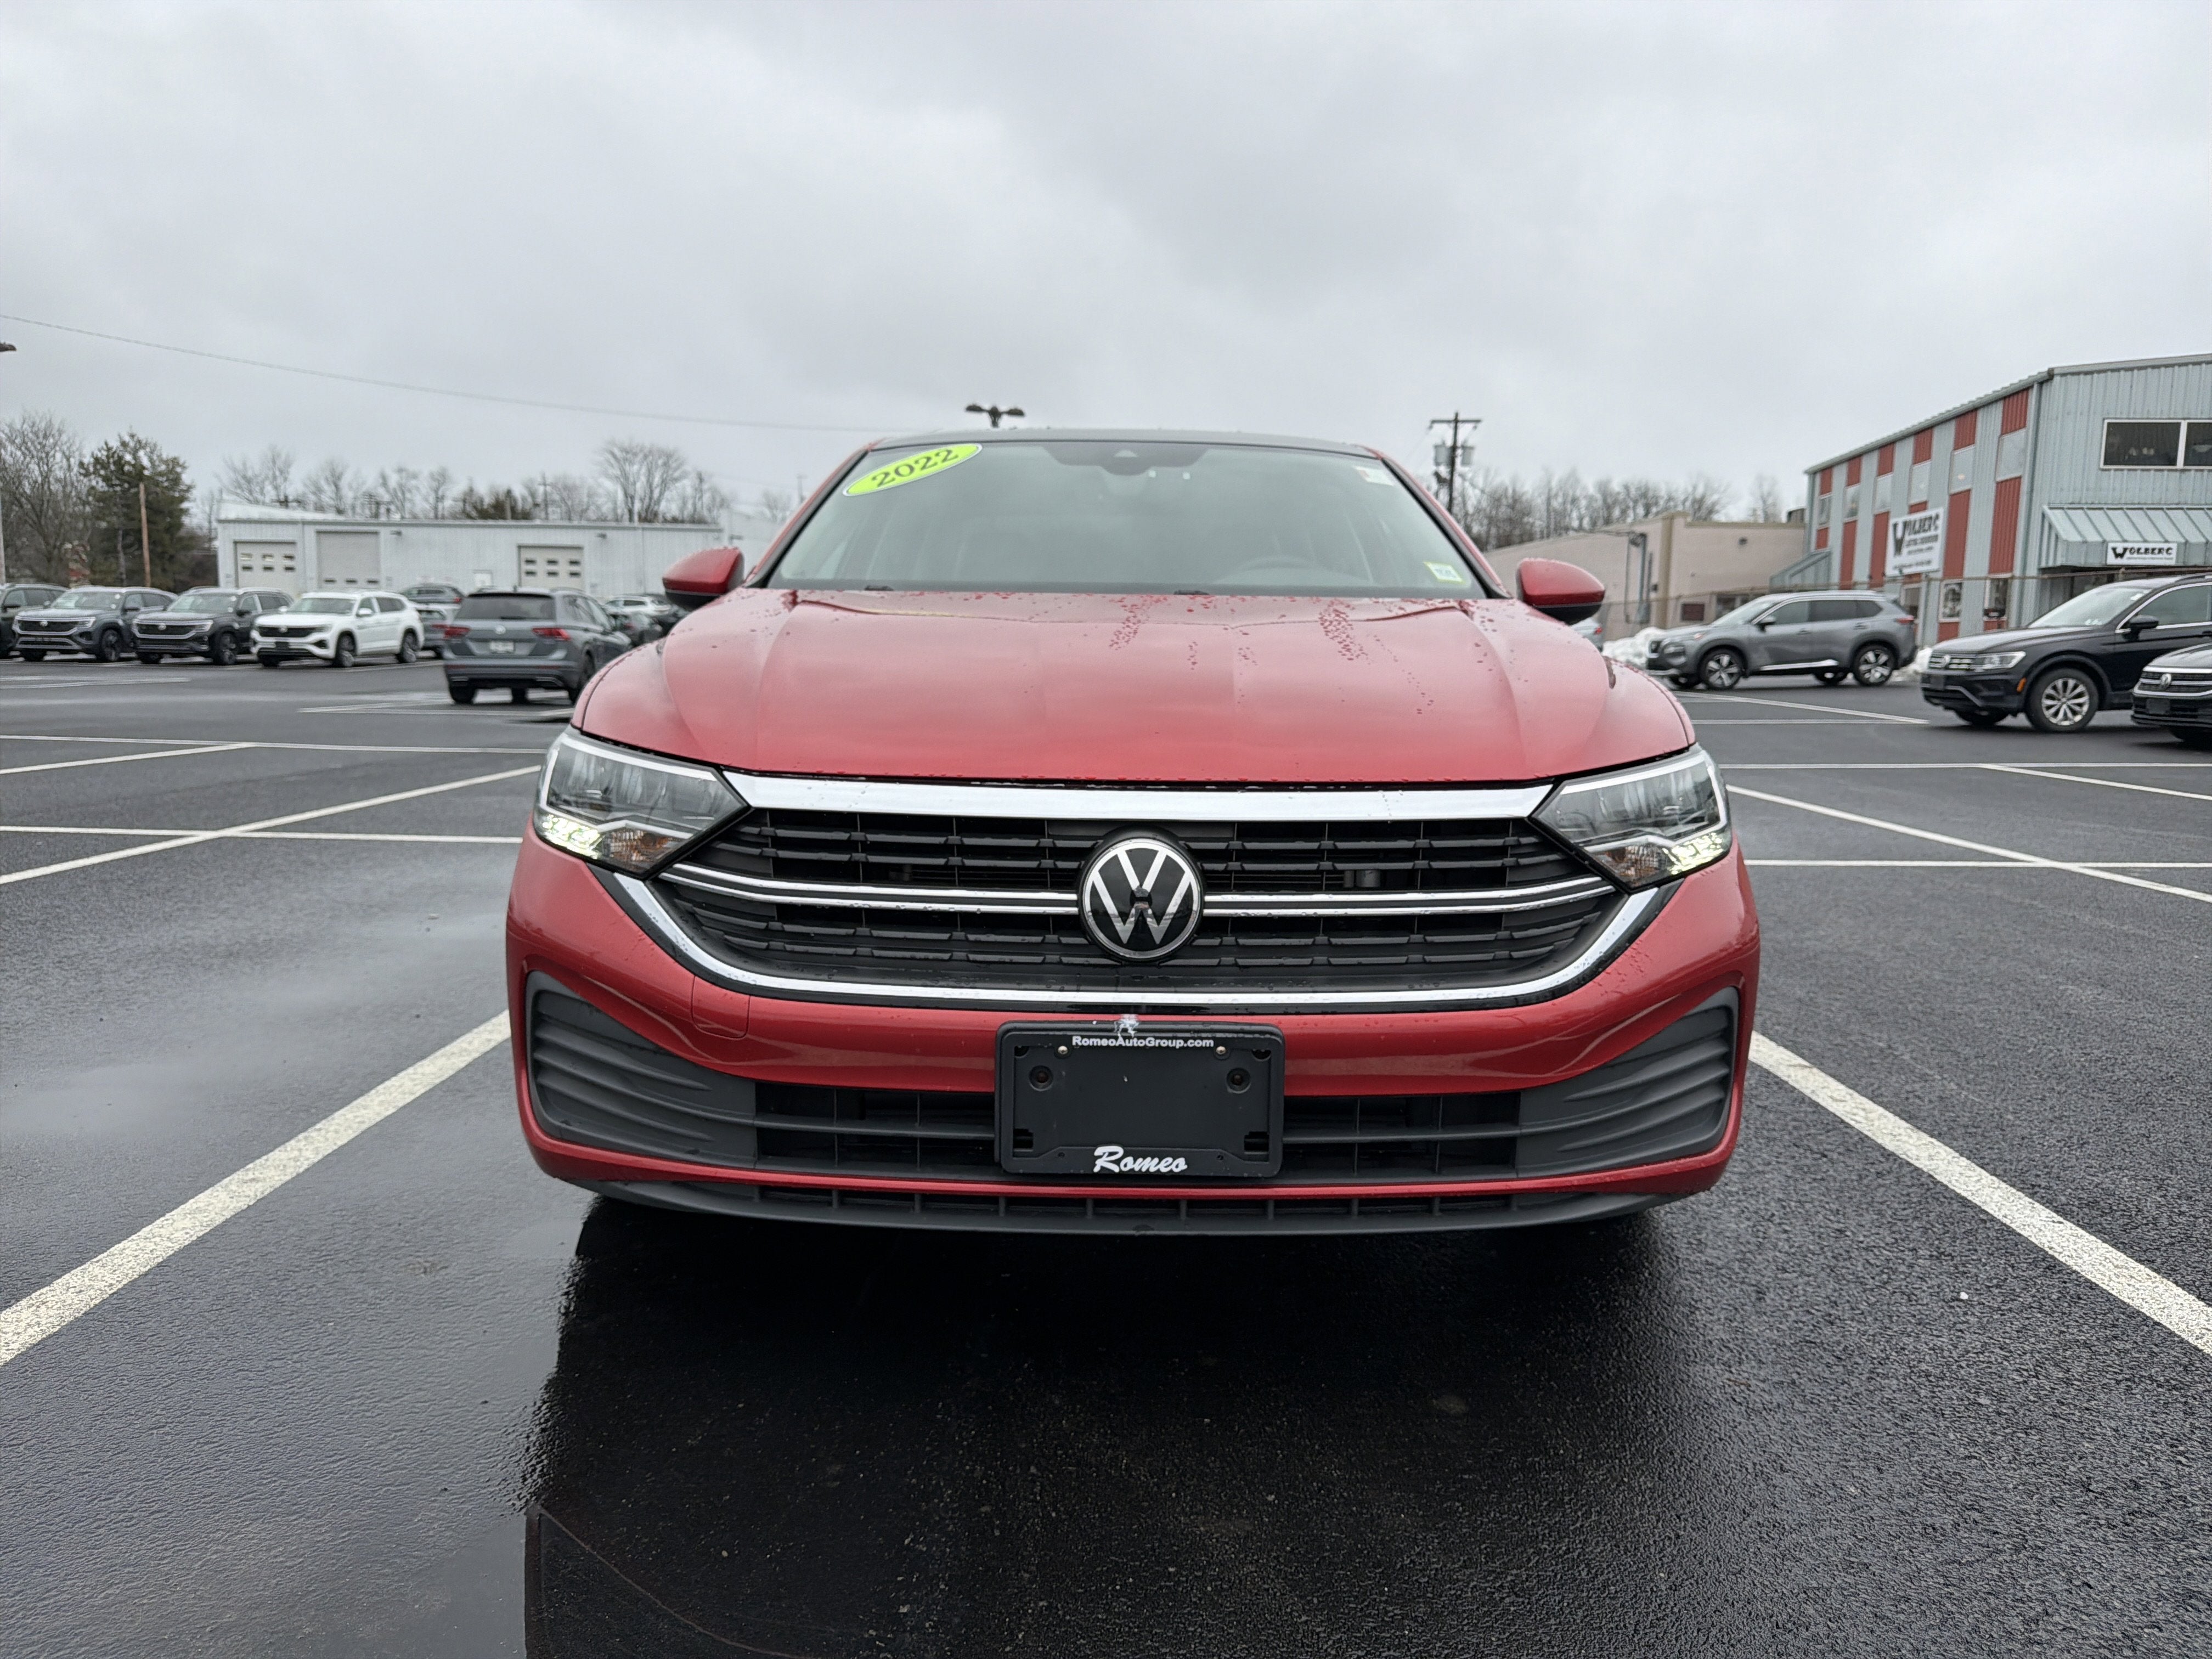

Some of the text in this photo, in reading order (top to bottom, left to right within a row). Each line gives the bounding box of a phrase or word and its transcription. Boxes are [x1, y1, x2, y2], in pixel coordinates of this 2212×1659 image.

[871, 449, 959, 488] 2022
[1072, 1036, 1214, 1048] RomeoAutoGroup.com
[1093, 1146, 1188, 1173] Romeo
